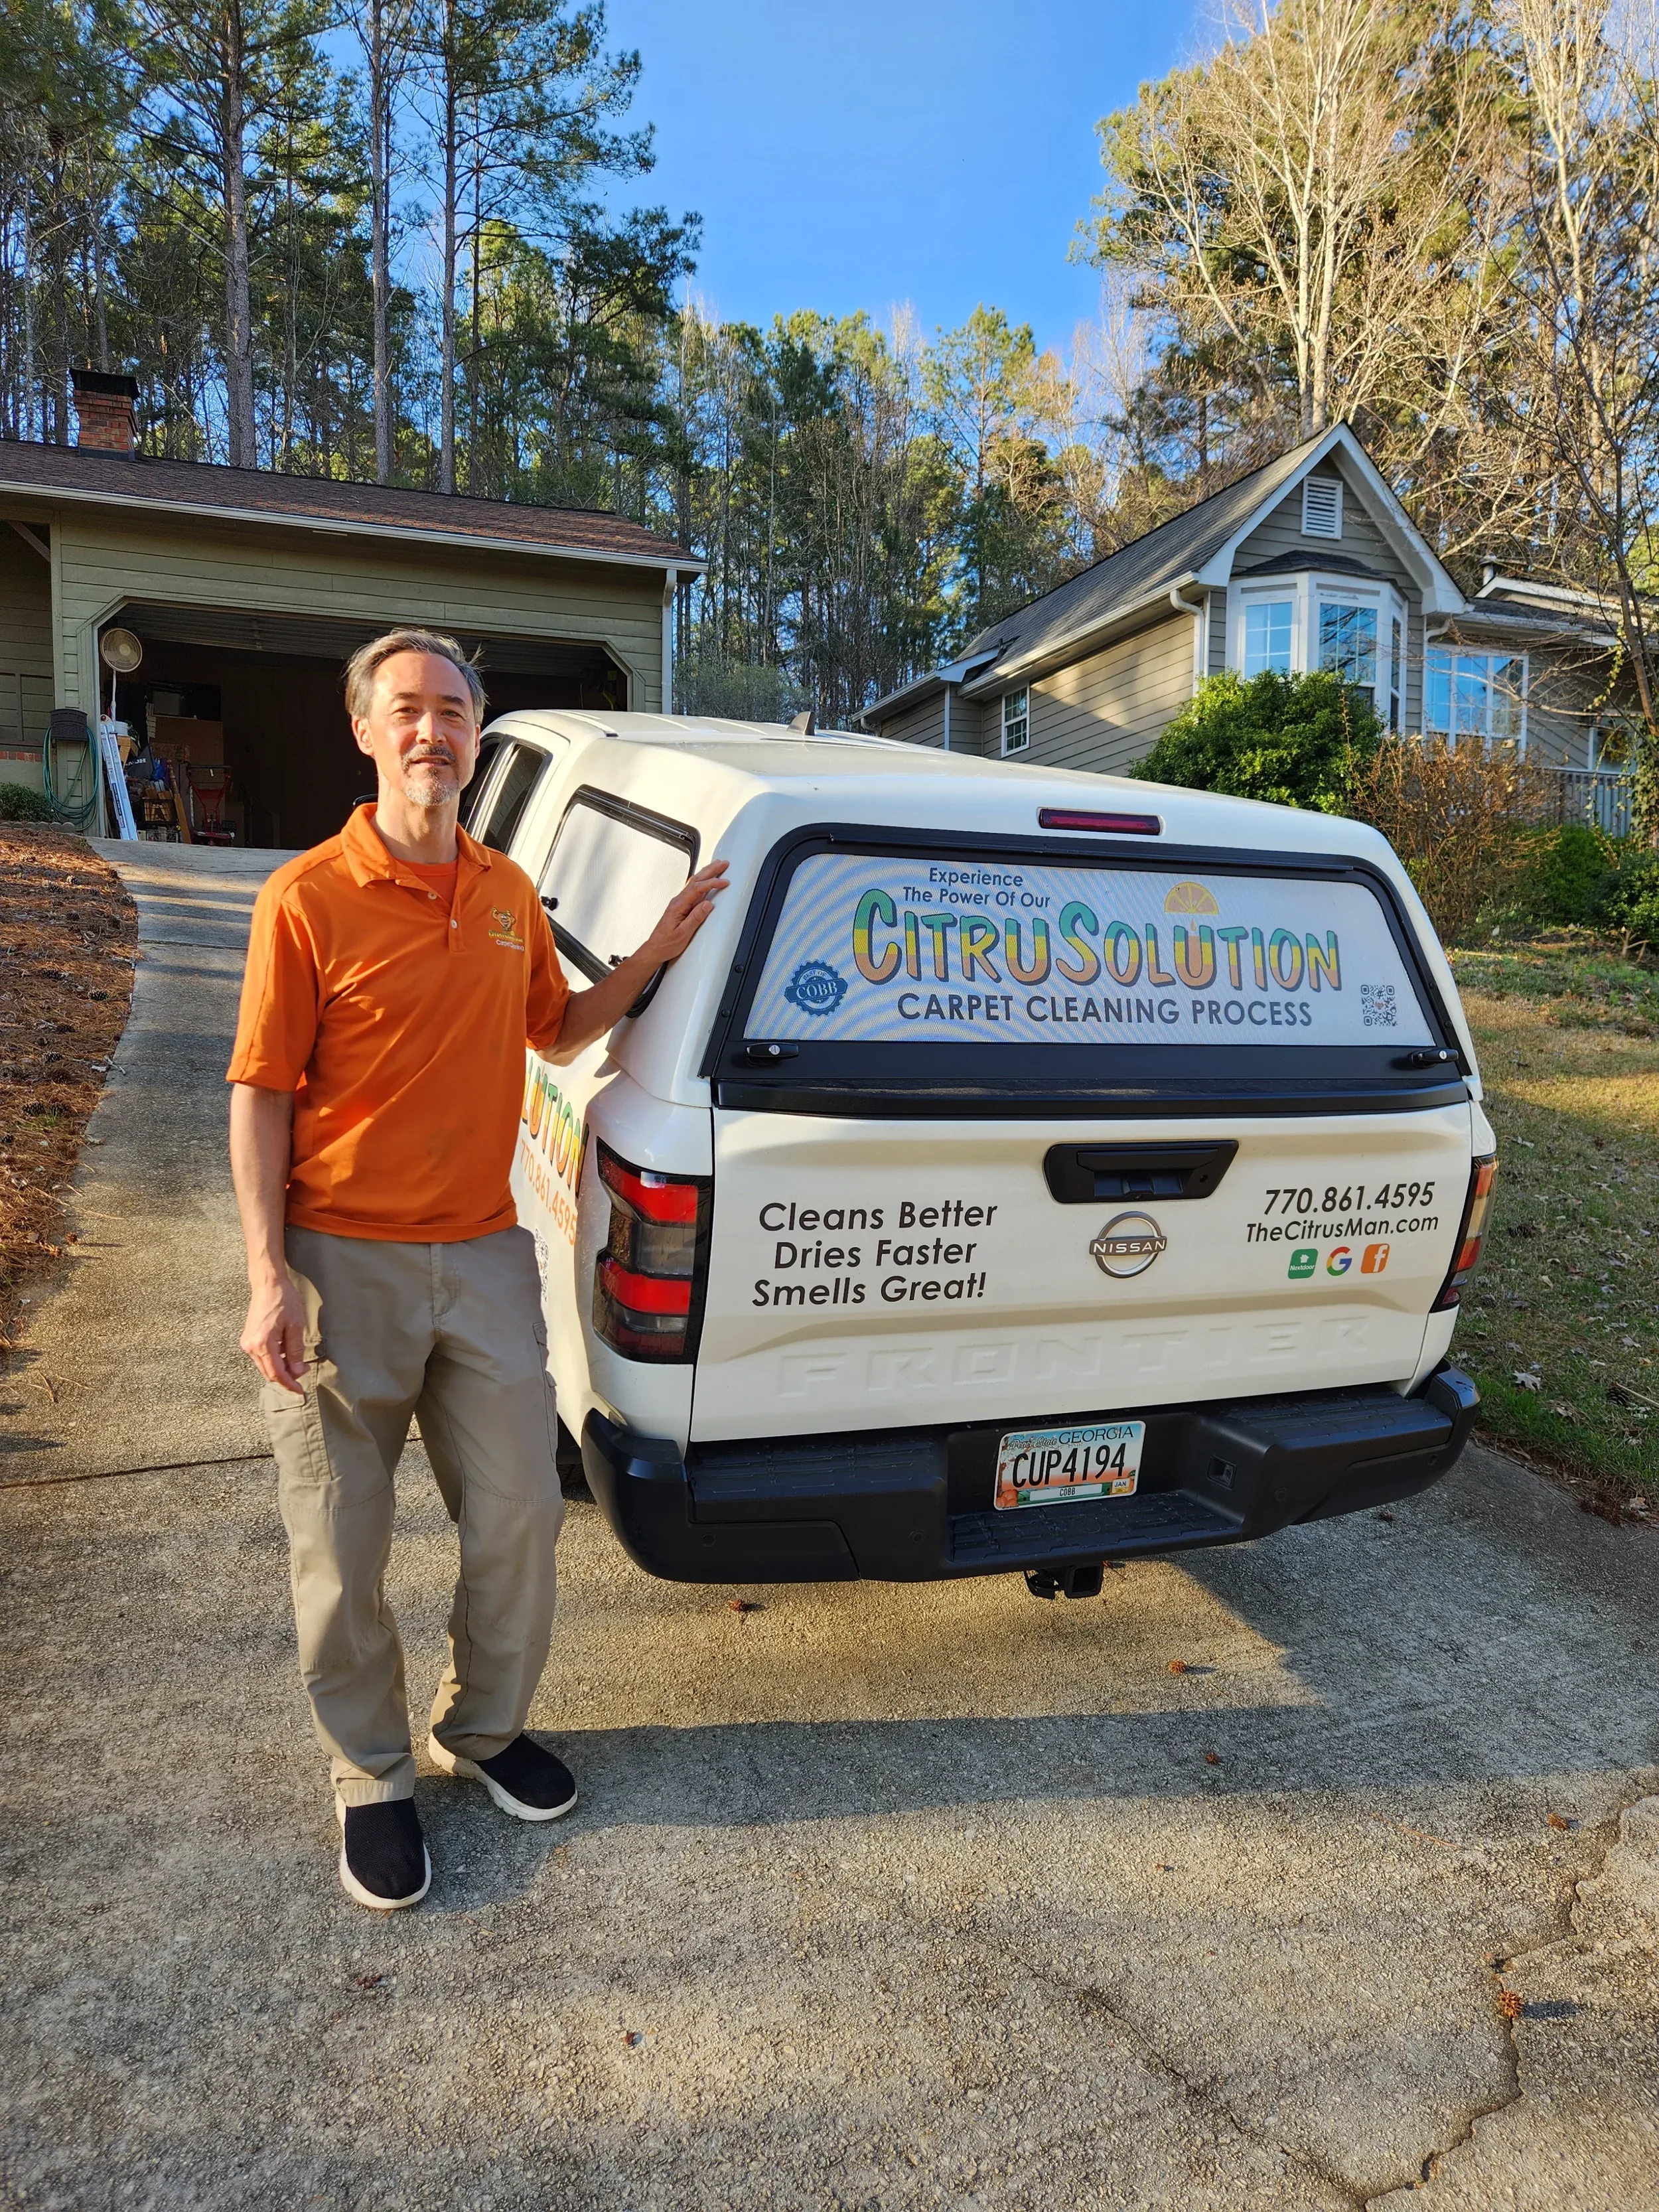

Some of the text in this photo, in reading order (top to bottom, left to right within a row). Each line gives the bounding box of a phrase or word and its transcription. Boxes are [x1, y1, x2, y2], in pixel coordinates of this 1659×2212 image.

[125, 758, 147, 767] HON
[929, 867, 1023, 887] Experience
[903, 886, 1050, 907] The Power Of Our
[802, 970, 816, 981] BEST
[796, 982, 837, 999] COBB
[898, 992, 1313, 1027] CARPET CLEANING PROCESS
[521, 1056, 589, 1199] LUTION
[521, 1138, 577, 1246] 770.861.4595
[1263, 1181, 1435, 1215] 770.861.4595
[759, 1200, 998, 1231] Cleans Better
[1247, 1216, 1439, 1242] TheCitrusMan.com
[774, 1238, 977, 1269] Dries Faster
[1093, 1240, 1165, 1253] NISSAN
[1372, 1244, 1389, 1272] f
[1326, 1246, 1352, 1276] G
[752, 1272, 986, 1307] Smells Great!
[778, 1315, 1371, 1398] FRONTIER
[1035, 1436, 1058, 1447] State
[1058, 1426, 1133, 1445] GEORGIA
[1012, 1443, 1126, 1489] CUP4194
[1059, 1487, 1076, 1497] COBB
